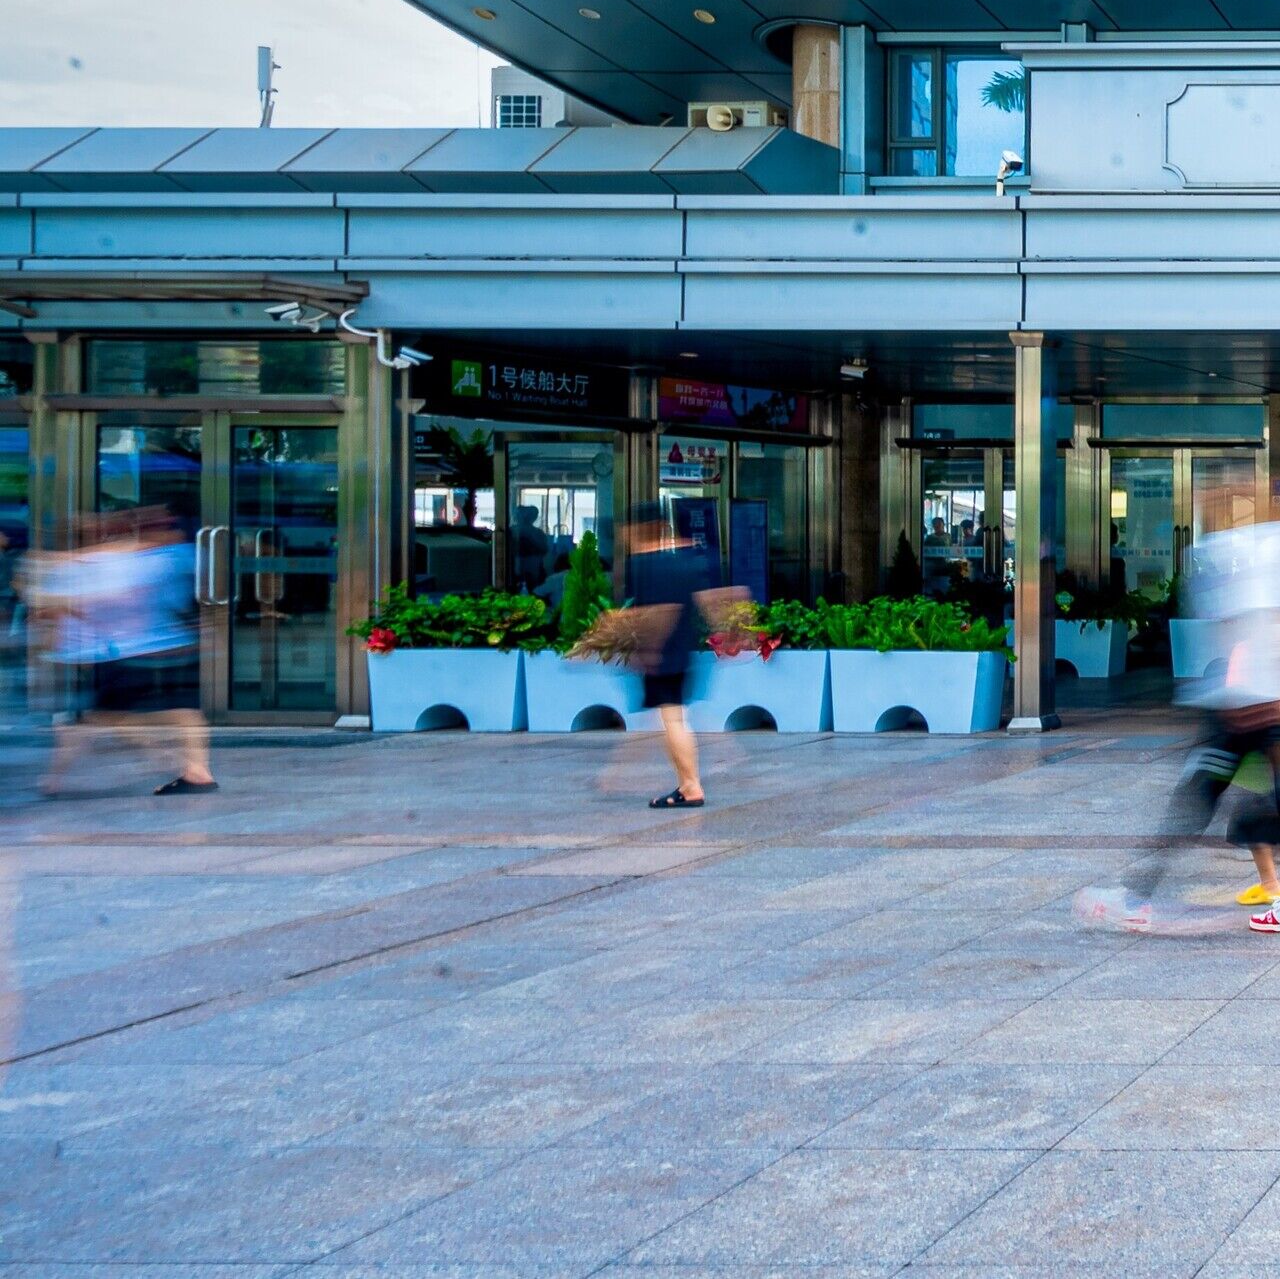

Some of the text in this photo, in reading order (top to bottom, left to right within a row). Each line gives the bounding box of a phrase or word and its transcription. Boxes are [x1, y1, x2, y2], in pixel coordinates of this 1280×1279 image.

[488, 364, 589, 396] 1号候船大厅
[512, 392, 548, 406] Waiting
